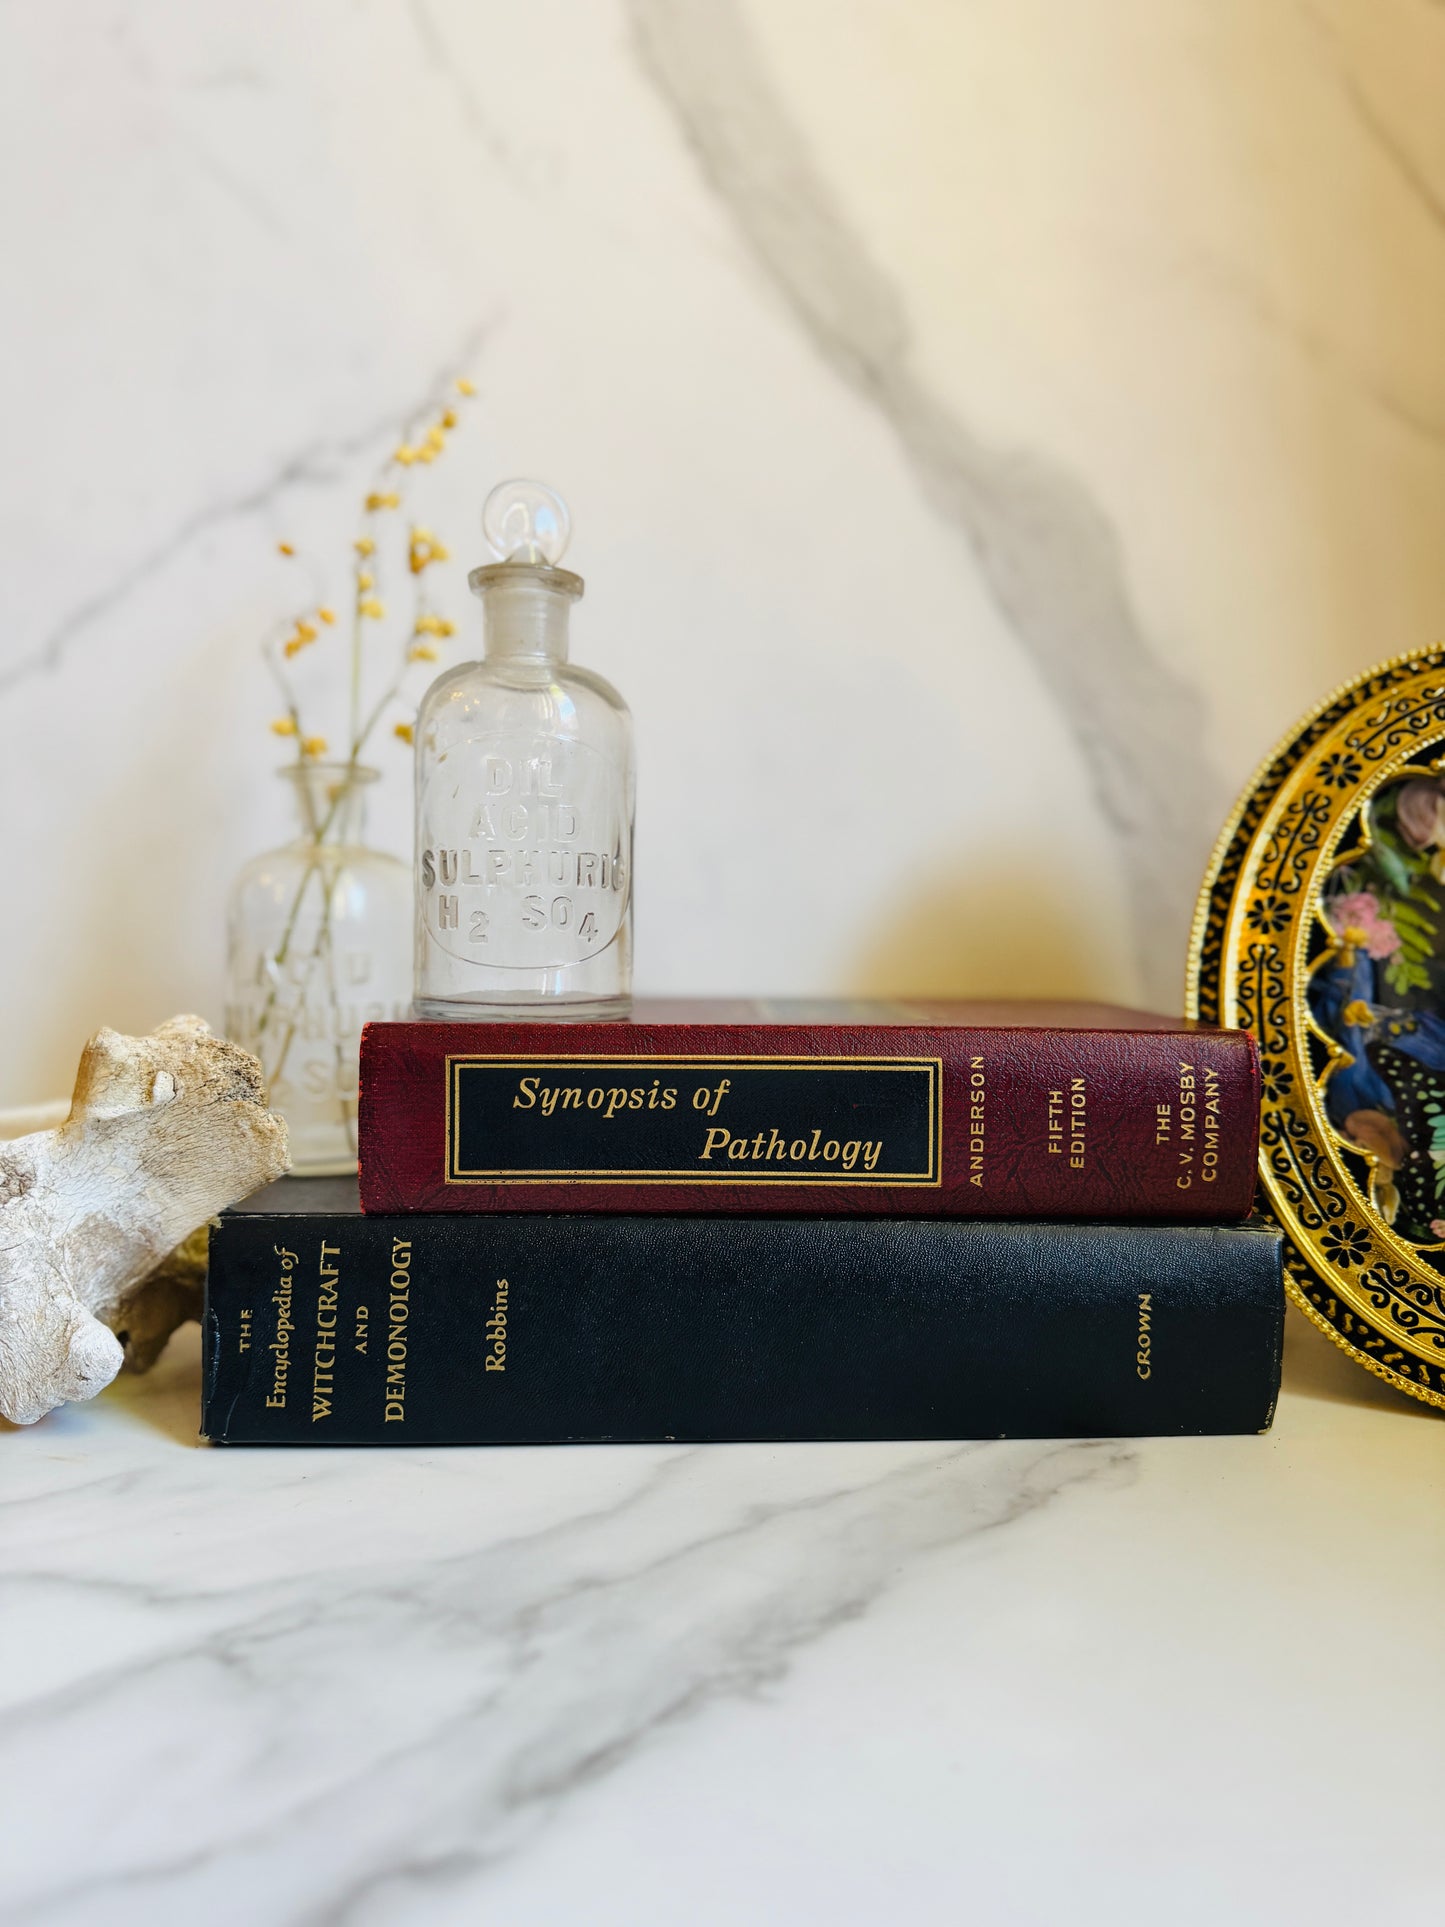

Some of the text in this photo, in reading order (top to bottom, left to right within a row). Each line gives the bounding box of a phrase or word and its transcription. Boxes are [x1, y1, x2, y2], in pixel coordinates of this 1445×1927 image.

[485, 757, 563, 797] DIL
[468, 803, 580, 843] ACID
[513, 1077, 730, 1118] Synopsis of
[969, 1056, 986, 1188] ANDERSON
[1048, 1090, 1064, 1154] FIFTH
[1070, 1077, 1086, 1169] EDITION
[1155, 1103, 1171, 1145] THE
[1176, 1061, 1196, 1190] C. V. MOSBY
[1201, 1067, 1221, 1183] COMPANY
[697, 1127, 883, 1170] Pathology
[239, 1309, 253, 1353] THE
[265, 1244, 299, 1409] Encyclopedia of
[311, 1240, 341, 1423] WITCHCRAFT
[354, 1305, 369, 1355] AND
[384, 1236, 412, 1422] DEMONOLOGY
[485, 1278, 509, 1372] Robbins
[1136, 1293, 1152, 1381] CROWN
